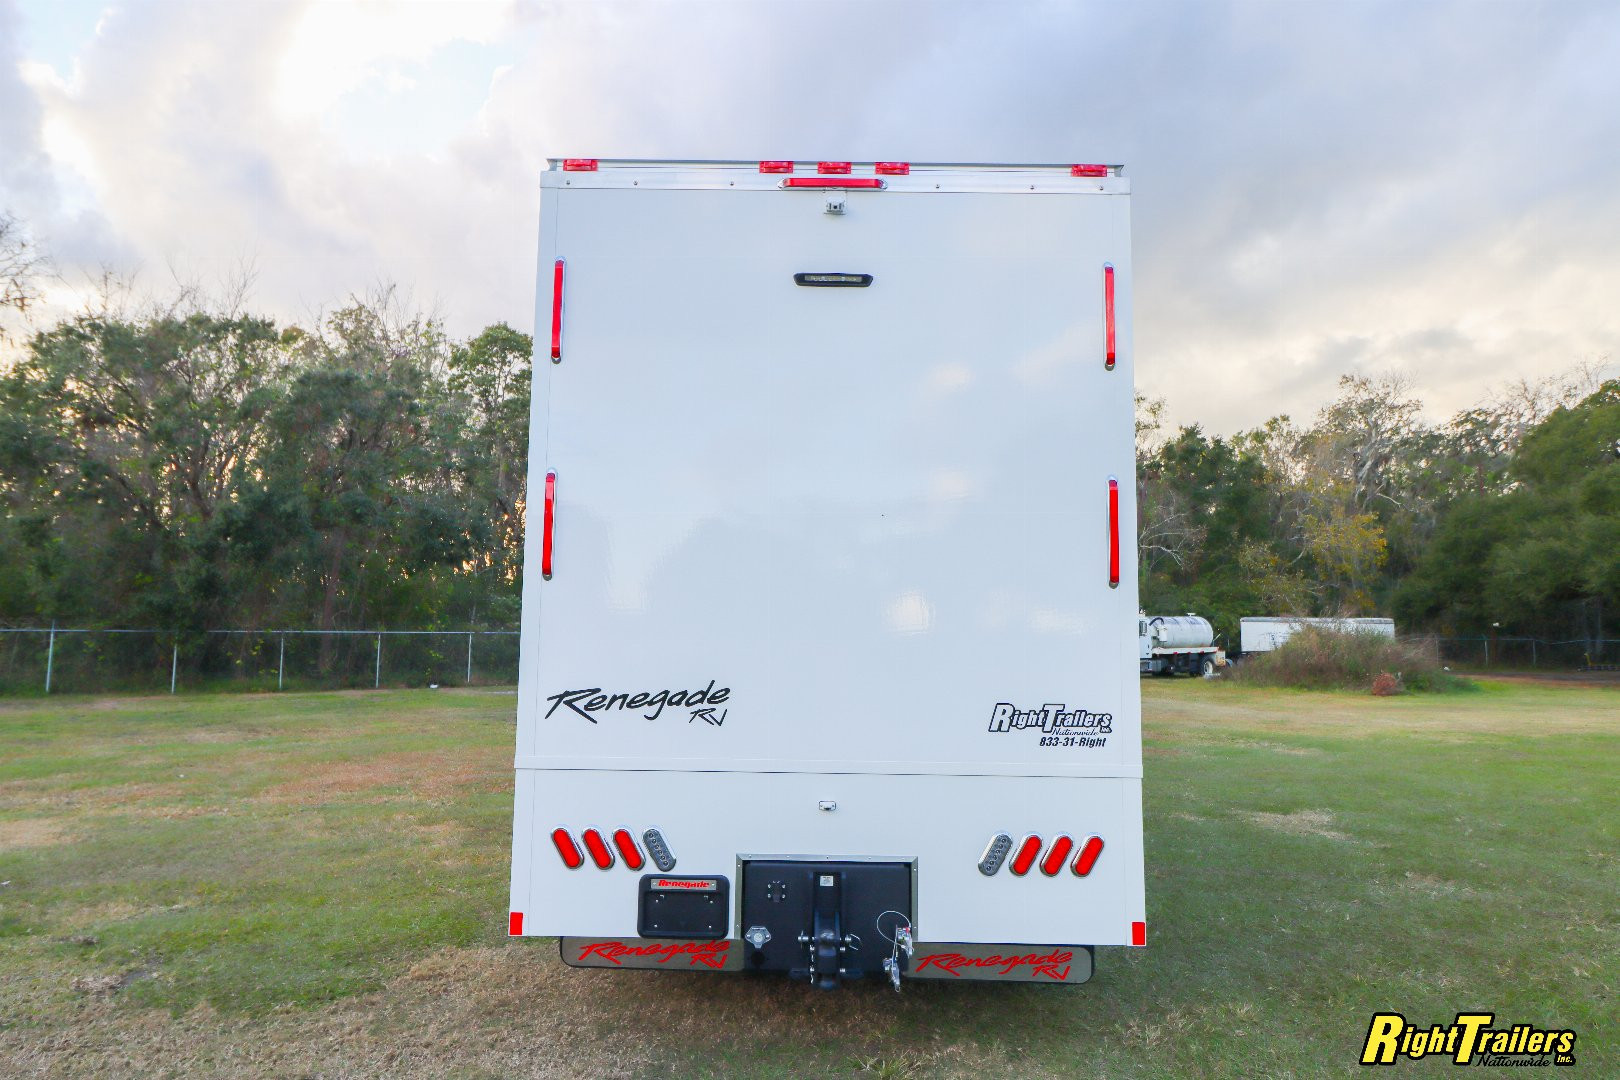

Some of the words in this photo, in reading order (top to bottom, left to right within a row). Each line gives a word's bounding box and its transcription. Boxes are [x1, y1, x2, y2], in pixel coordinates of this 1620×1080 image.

[544, 679, 731, 724] Renegade
[688, 707, 728, 727] RV
[1039, 736, 1107, 748] 833-31-Right
[658, 879, 710, 889] Renegade
[577, 939, 731, 965] Renegade
[689, 953, 728, 969] RV
[915, 948, 1073, 977] Renegade
[1032, 964, 1071, 981] RV
